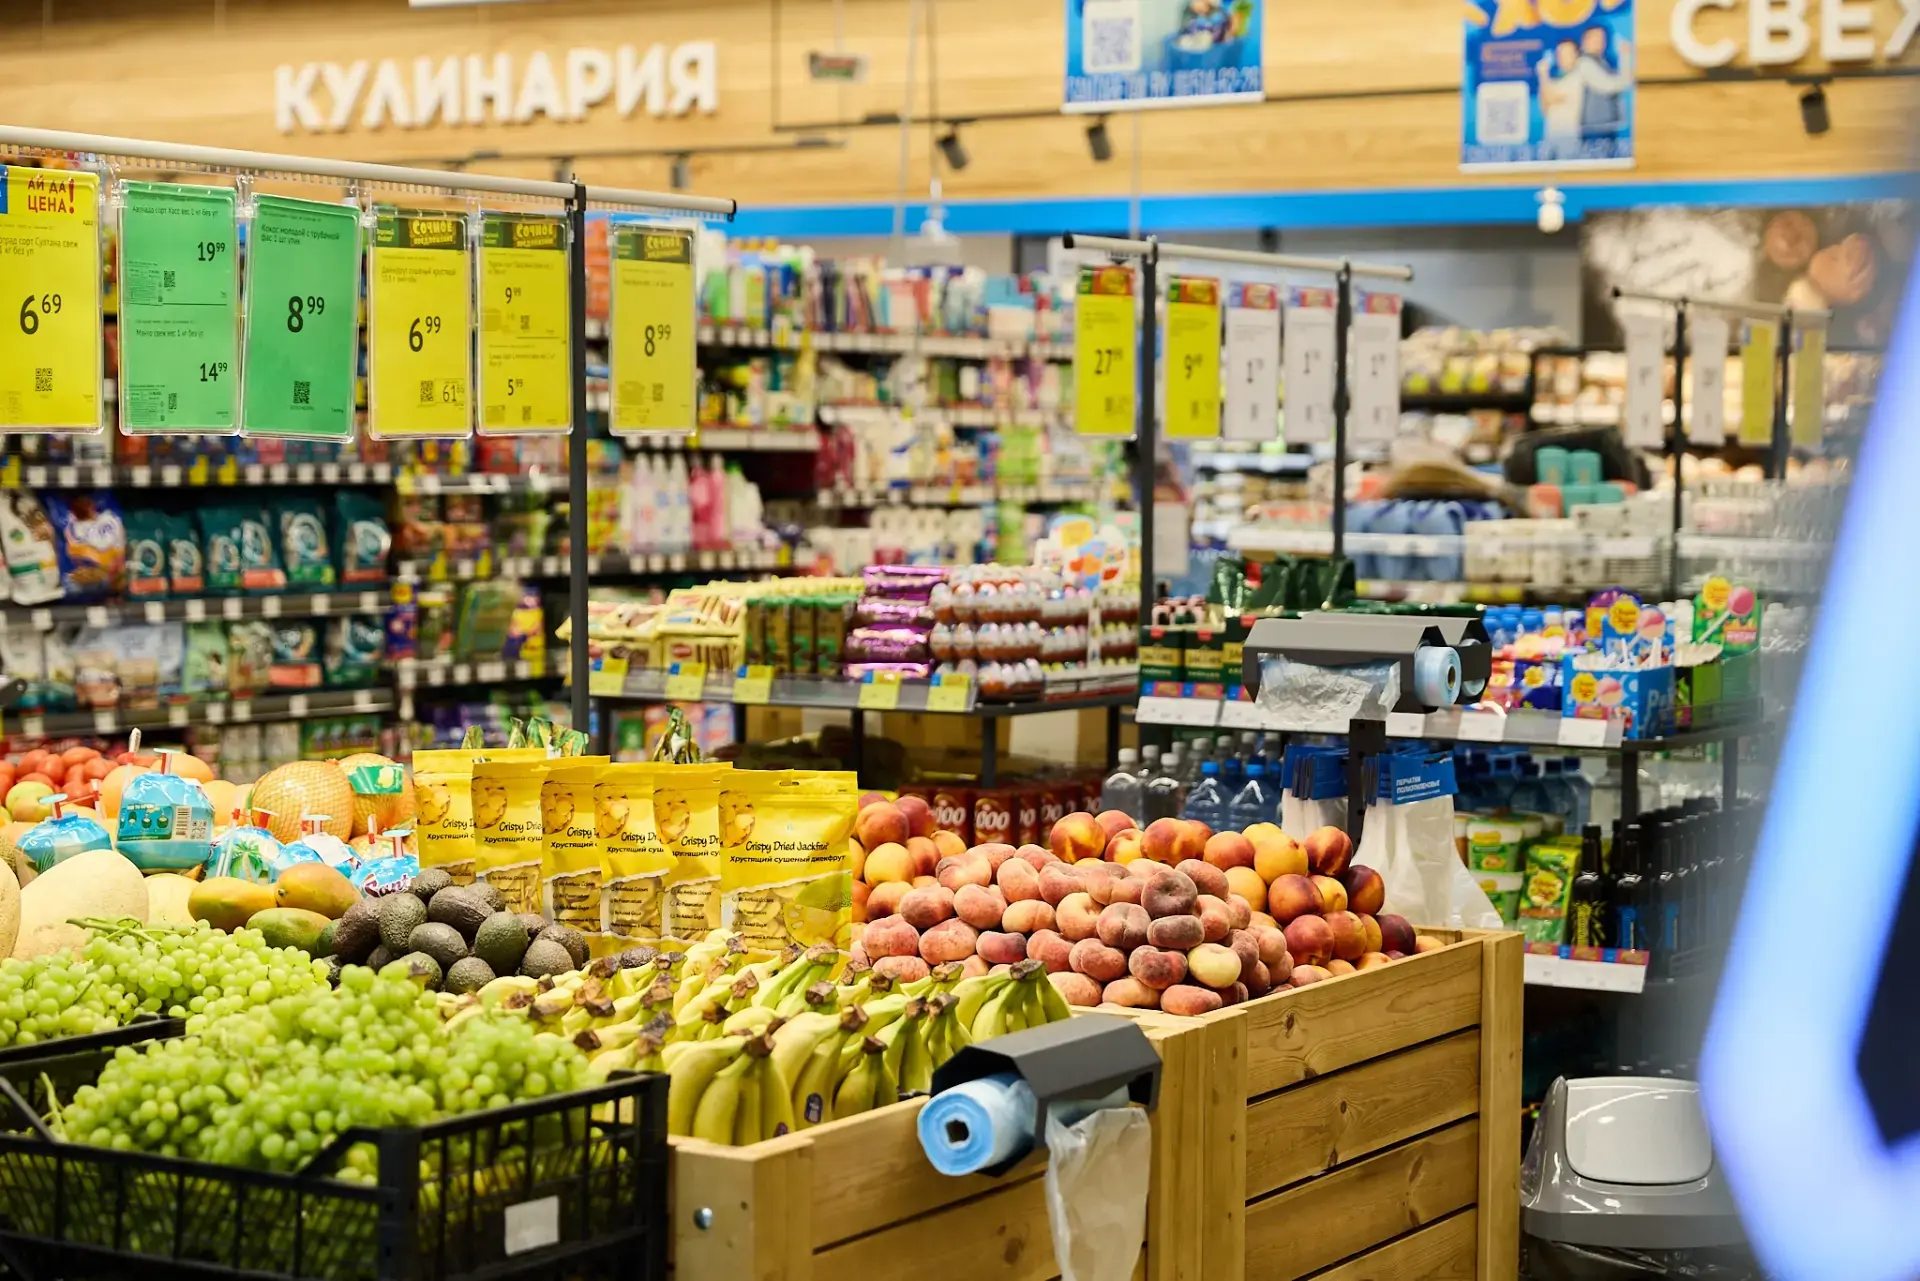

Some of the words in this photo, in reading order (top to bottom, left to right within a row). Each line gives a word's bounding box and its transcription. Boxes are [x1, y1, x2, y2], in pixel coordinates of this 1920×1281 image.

[274, 40, 717, 133] КУЛИНАРИЯ
[28, 174, 44, 191] АЙ
[49, 180, 66, 194] ДА
[442, 818, 467, 830] Crispy
[499, 821, 524, 833] Crispy
[567, 826, 592, 838] Crispy
[621, 832, 645, 844] Crispy
[484, 836, 525, 844] Хрустящий
[551, 840, 593, 849] Хрустящий
[681, 836, 707, 847] Crispy
[746, 840, 771, 854] Crispy
[773, 841, 795, 851] Dried
[730, 855, 773, 864] Хрустящий
[774, 855, 810, 864] сушеный
[811, 854, 846, 863] джекфрут
